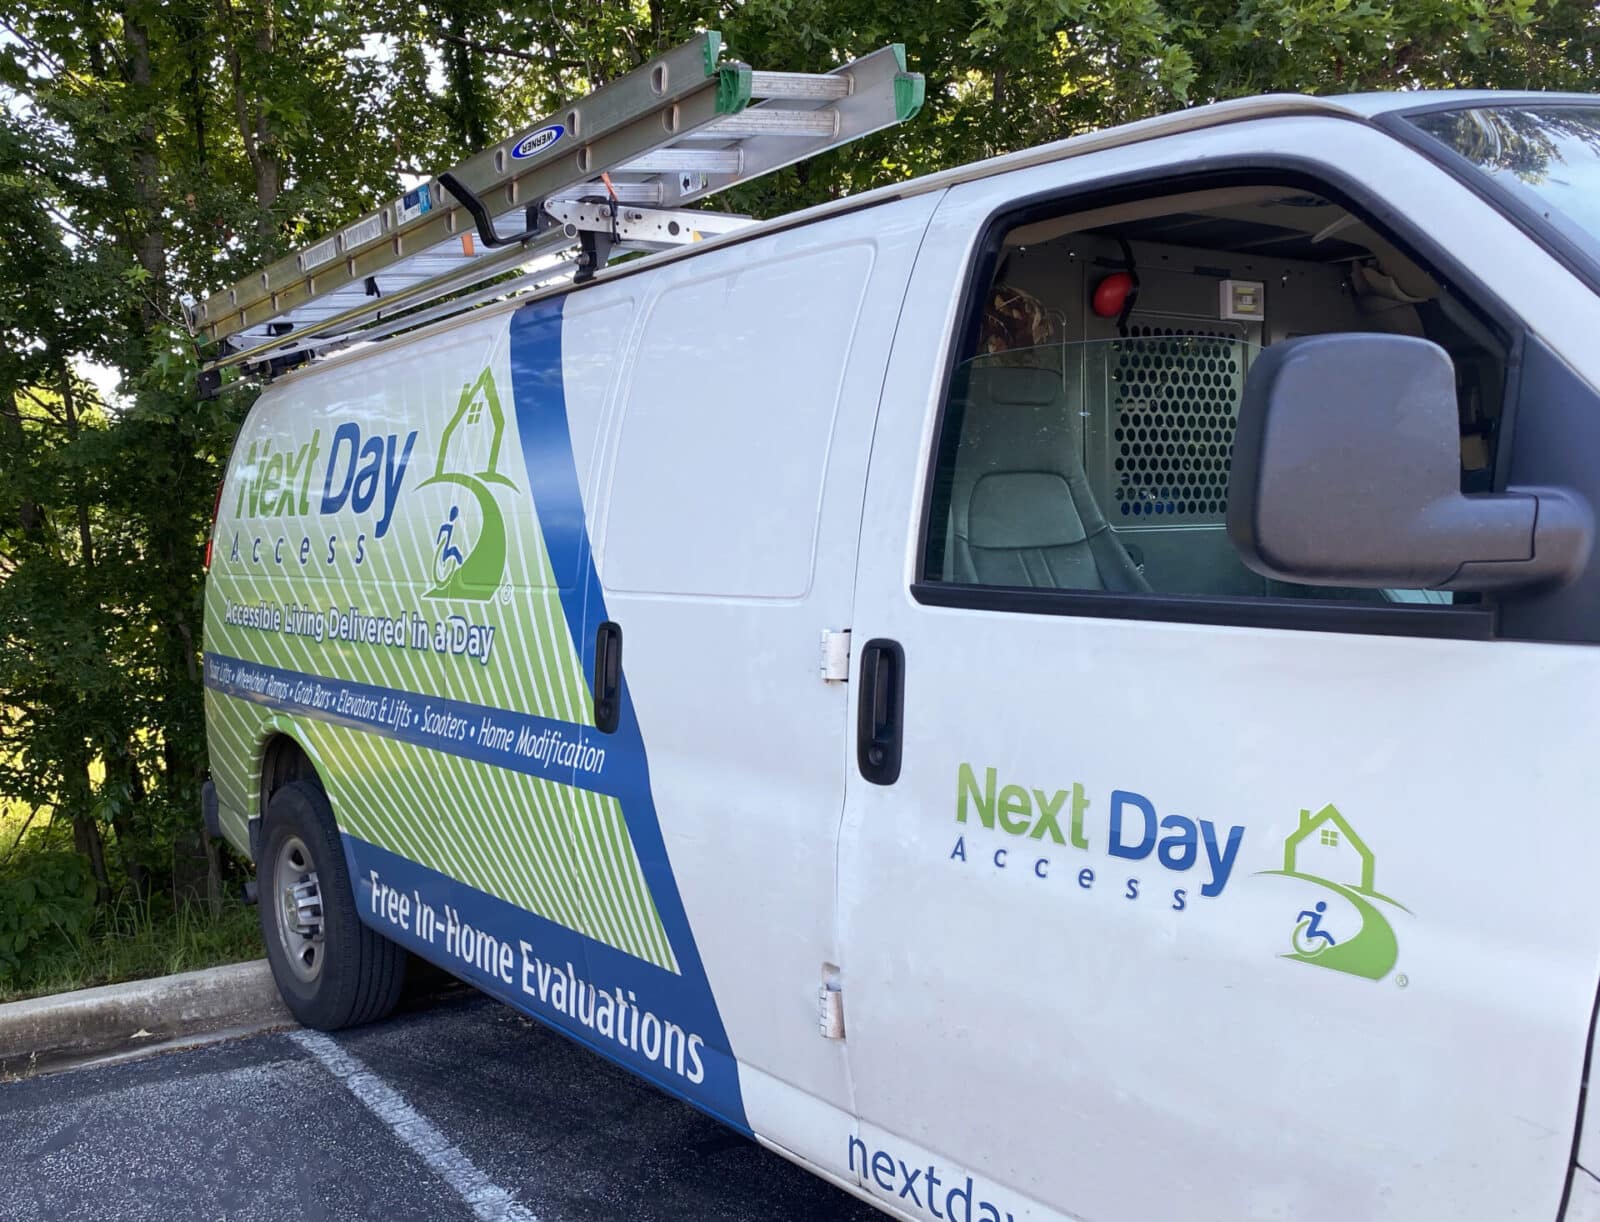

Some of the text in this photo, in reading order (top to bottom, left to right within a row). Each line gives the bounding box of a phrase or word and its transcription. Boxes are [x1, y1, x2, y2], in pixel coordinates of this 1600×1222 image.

[235, 422, 418, 539] Next Day
[230, 531, 366, 564] Access
[225, 598, 496, 664] Accessible Living Delivered in a Day
[294, 680, 313, 706] Grab
[312, 688, 332, 708] Bars
[337, 690, 378, 720] Elevators
[378, 697, 387, 722] &
[387, 697, 412, 731] Lifts
[420, 705, 467, 741] Scooters
[477, 714, 515, 753] Home
[515, 727, 606, 774] Modification
[951, 836, 1187, 911] Access
[956, 763, 1245, 897] Next Day
[370, 870, 706, 1084] Free In-Home Evaluations
[848, 1134, 1014, 1222] nextda
